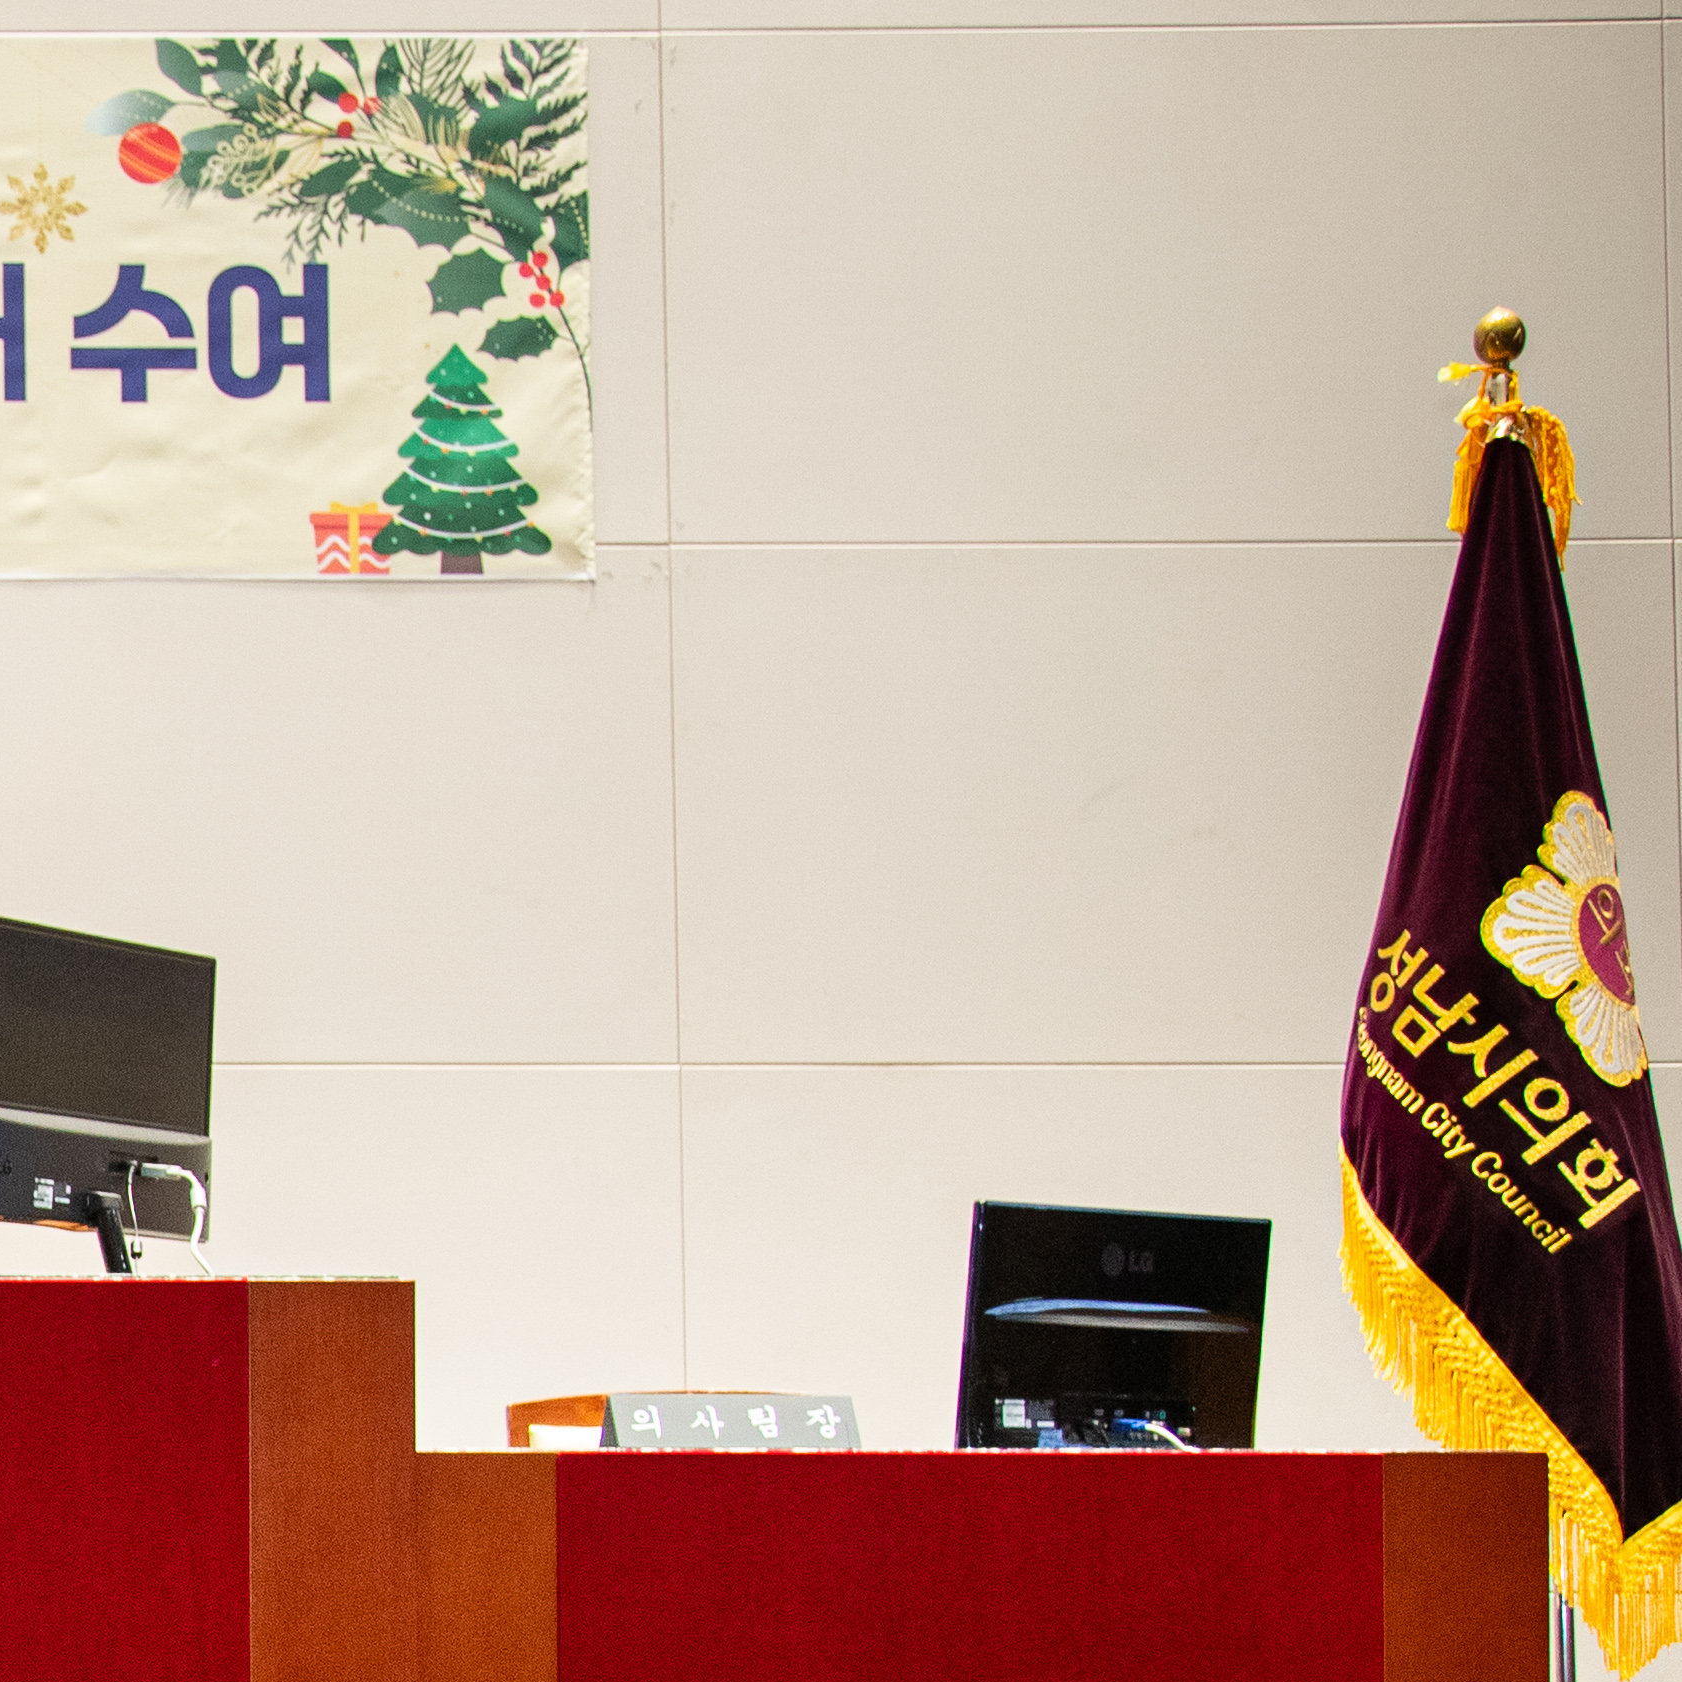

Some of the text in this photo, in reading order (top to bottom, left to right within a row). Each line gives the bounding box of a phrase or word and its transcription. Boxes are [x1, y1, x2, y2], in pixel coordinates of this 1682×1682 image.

[70, 262, 332, 402] 수여
[1370, 929, 1641, 1229] 성남시의회
[1421, 1102, 1476, 1158] City
[1471, 1151, 1572, 1254] Council
[1127, 1250, 1154, 1272] LG
